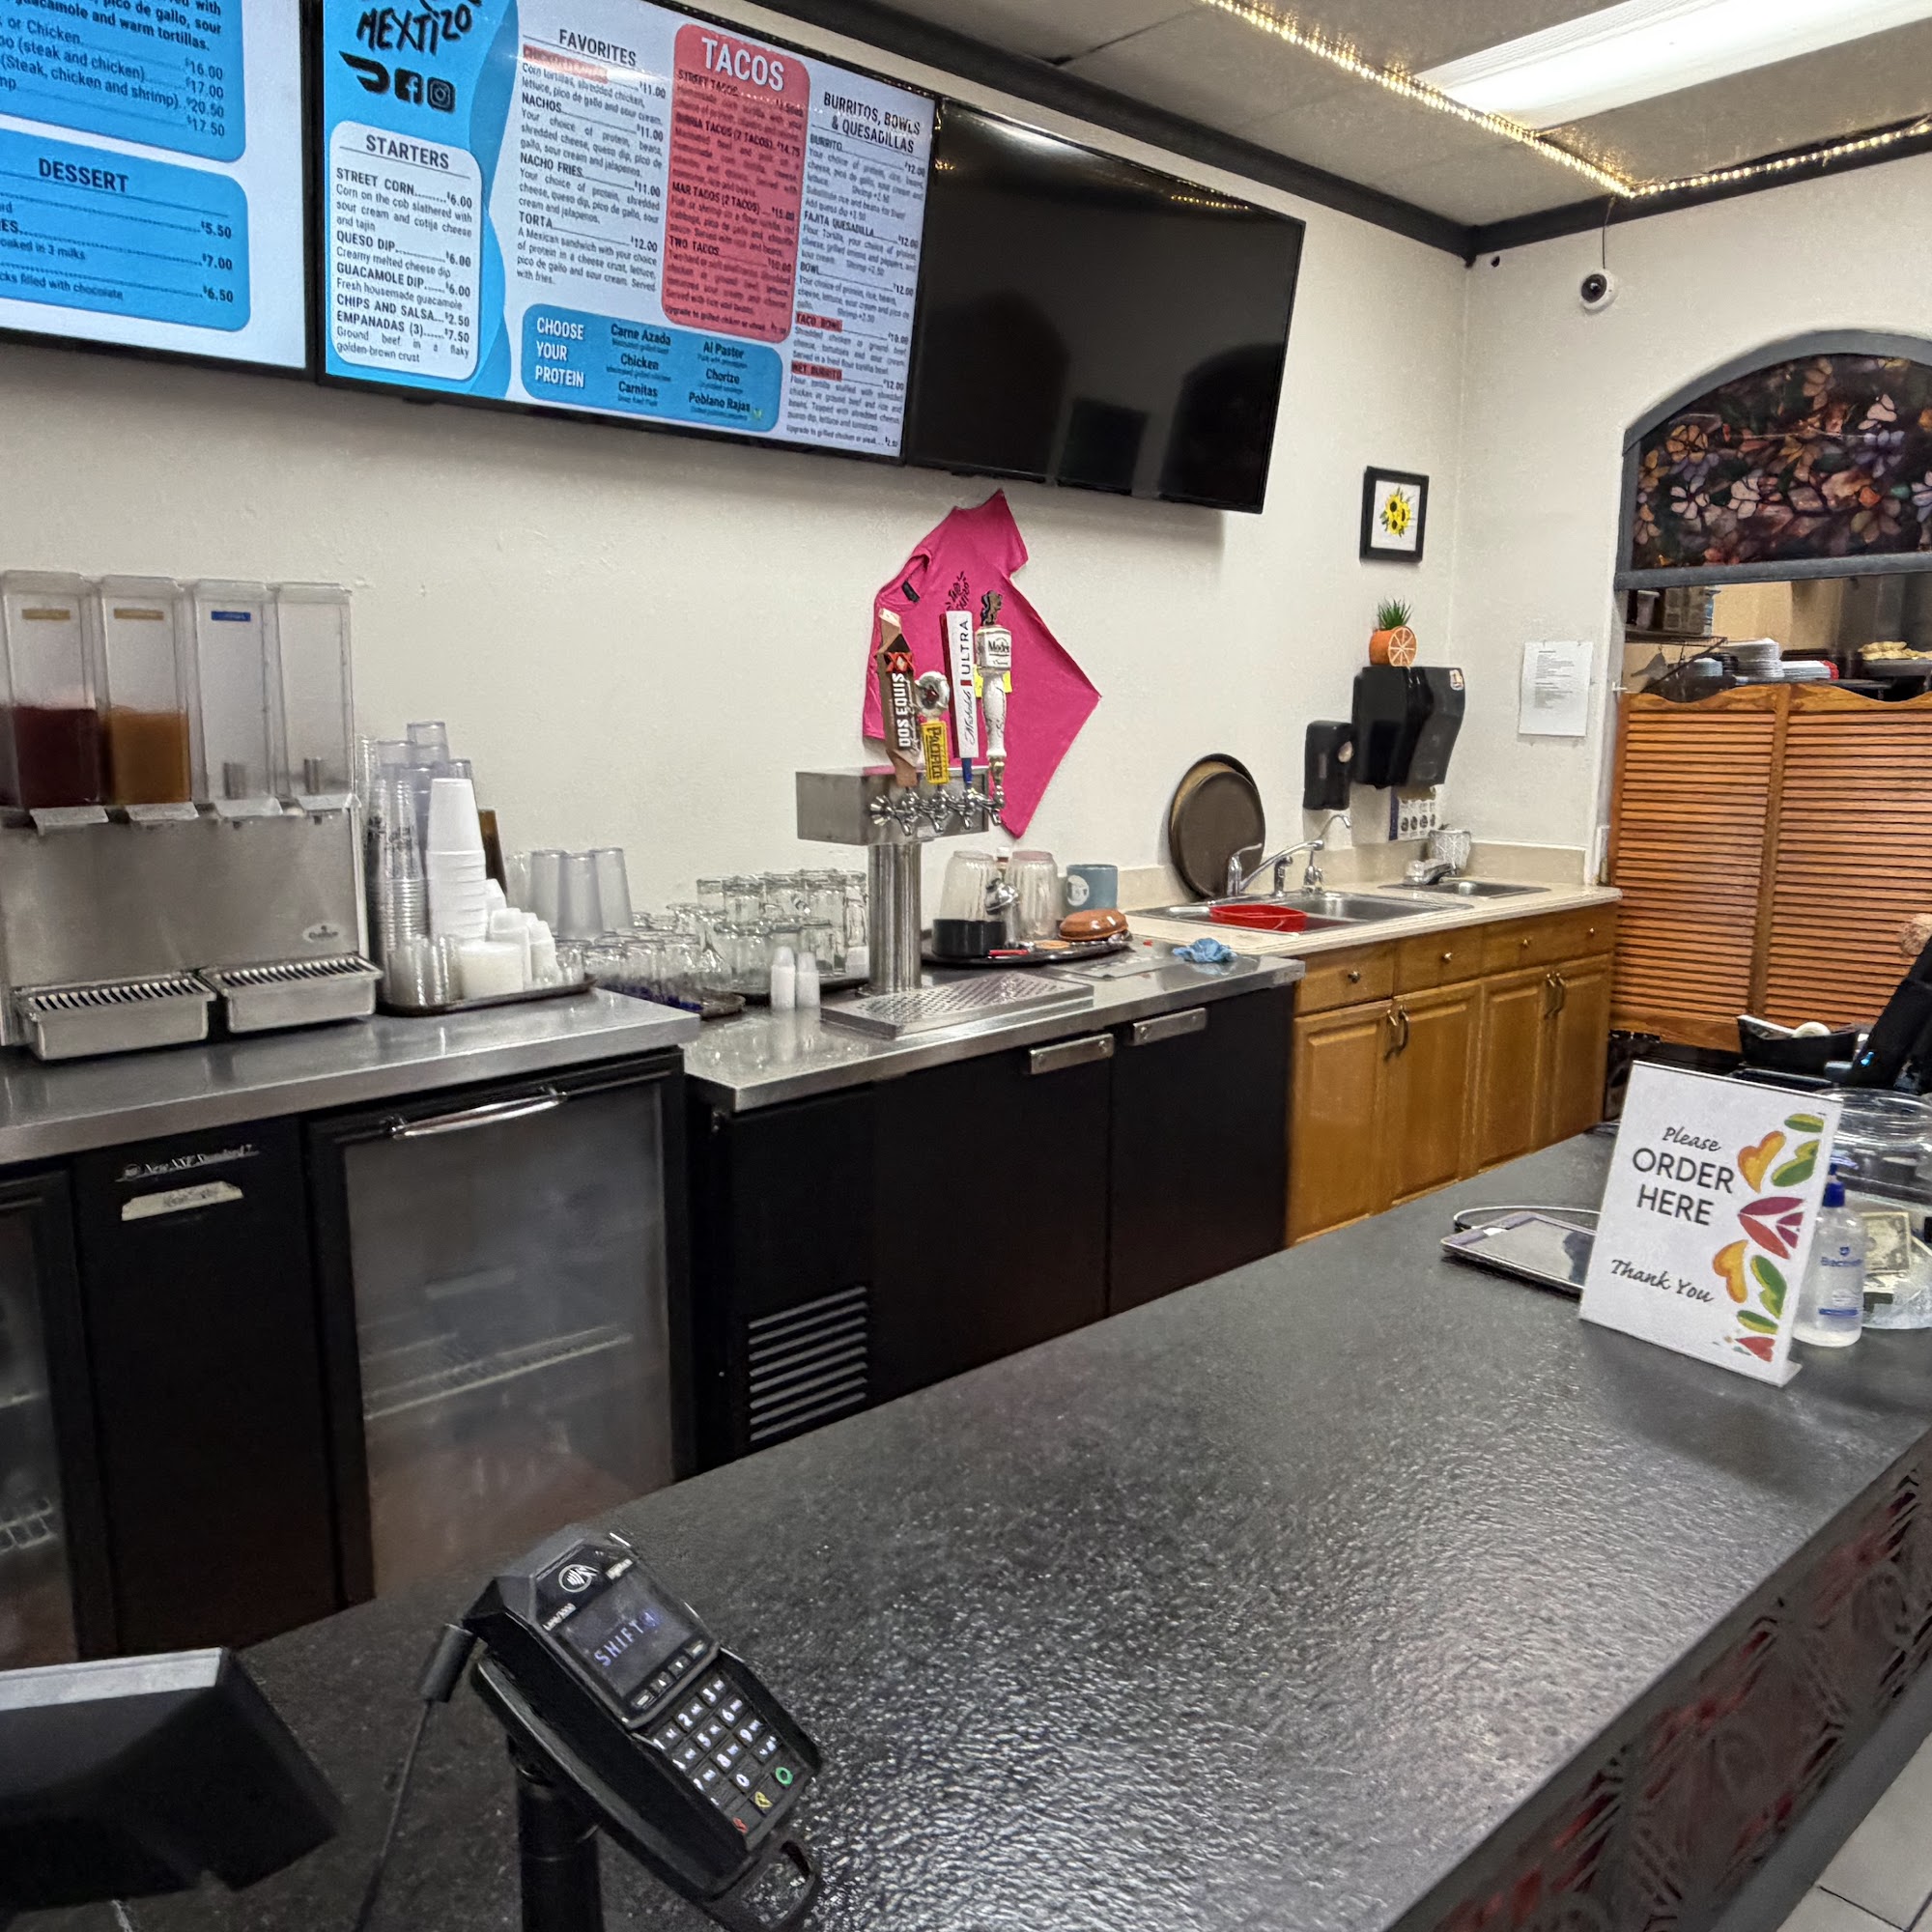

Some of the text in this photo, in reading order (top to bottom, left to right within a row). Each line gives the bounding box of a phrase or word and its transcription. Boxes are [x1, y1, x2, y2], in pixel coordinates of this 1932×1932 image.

[8, 17, 21, 30] or
[27, 19, 81, 44] Chicken
[93, 12, 115, 27] and
[120, 18, 155, 37] warm
[135, 0, 152, 16] de
[156, 8, 190, 29] gallo,
[195, 18, 222, 34] sour
[18, 36, 61, 60] (steak
[64, 52, 88, 67] and
[559, 28, 638, 68] FAVORITES
[701, 36, 784, 92] TACOS
[51, 67, 102, 89] chicken
[105, 81, 128, 97] and
[522, 92, 562, 114] NACHOS
[823, 91, 881, 127] BURRITOS,
[884, 111, 921, 135] BOWLS
[831, 115, 915, 155] & QUESADILLAS
[365, 133, 450, 170] STARTERS
[520, 152, 554, 171] NACHO
[556, 161, 583, 178] FRIES
[38, 156, 130, 193] DESSERT
[336, 167, 473, 210] STREET CORN $6.00
[336, 184, 358, 199] Corn
[361, 191, 373, 202] on
[375, 192, 390, 206] the
[392, 198, 410, 212] cob
[336, 201, 356, 213] sour
[361, 206, 389, 220] cream
[393, 213, 411, 225] and
[200, 219, 233, 239] $5.50
[336, 215, 354, 229] and
[519, 211, 554, 229] TORTA
[201, 252, 234, 271] $7.00
[336, 230, 471, 269] QUESO DIP $6.00
[202, 285, 234, 303] $6.50
[336, 261, 471, 298] GUACAMOLE DIP $6.00
[336, 293, 470, 327] CHIPS AND SALSA $2.50
[336, 310, 470, 344] EMPANADAS (3) $7.50
[536, 316, 584, 341] CHOOSE
[611, 323, 639, 342] Carne
[535, 339, 568, 362] YOUR
[534, 364, 585, 388] PROTEIN
[618, 381, 659, 398] Carnitas
[959, 620, 972, 675] ULTRA
[892, 672, 908, 718] EQUIS
[897, 718, 912, 749] DOS
[1662, 1125, 1722, 1152] Please
[1632, 1147, 1736, 1195] ORDER
[1636, 1184, 1716, 1227] HERE
[1610, 1259, 1716, 1304] Thank You
